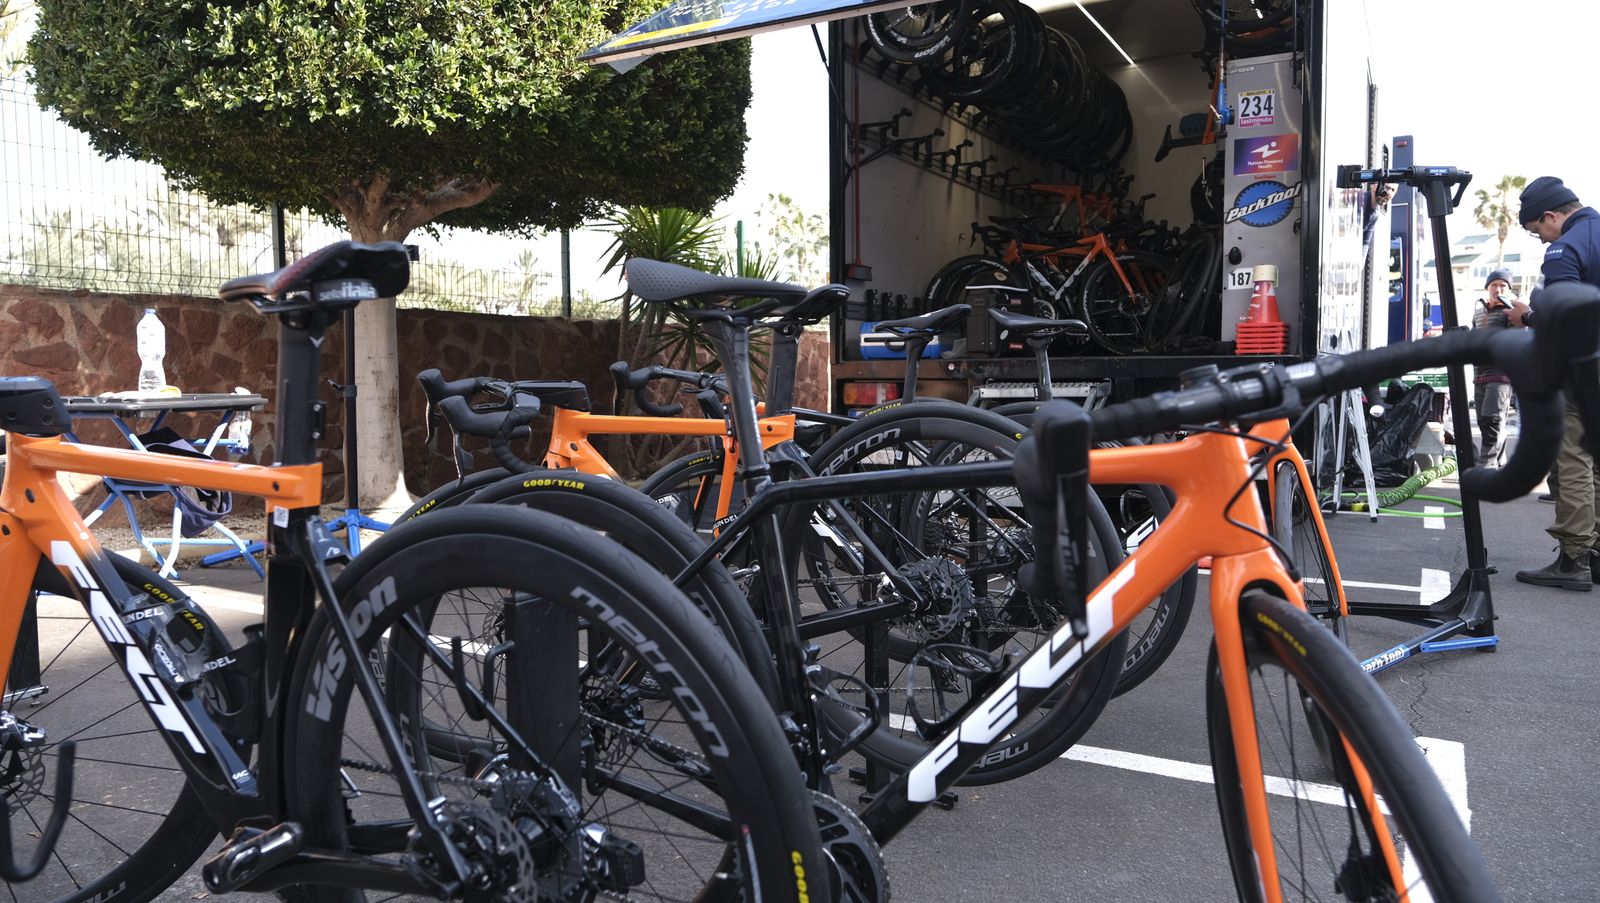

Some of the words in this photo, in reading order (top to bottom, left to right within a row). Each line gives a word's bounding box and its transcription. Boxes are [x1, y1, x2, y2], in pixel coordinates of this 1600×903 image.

[1240, 94, 1274, 117] 234
[1231, 272, 1251, 286] 187
[522, 479, 586, 490] GOODYEAR
[50, 540, 207, 755] FELT
[305, 575, 398, 722] vison
[569, 585, 730, 758] metron
[906, 558, 1137, 803] FELT
[1120, 603, 1170, 675] metro
